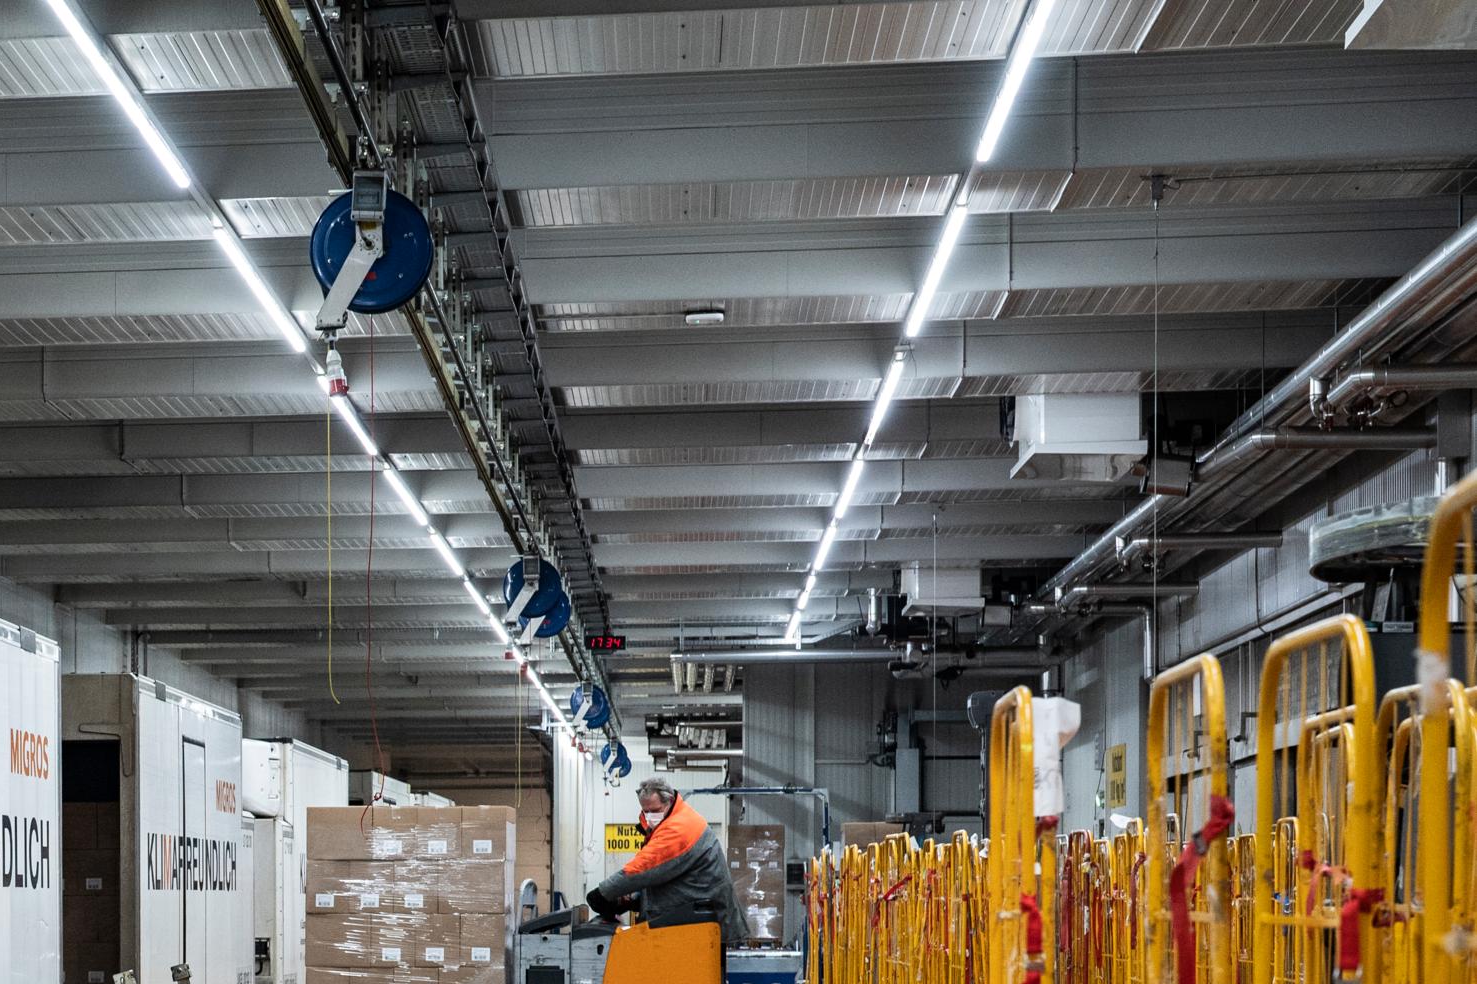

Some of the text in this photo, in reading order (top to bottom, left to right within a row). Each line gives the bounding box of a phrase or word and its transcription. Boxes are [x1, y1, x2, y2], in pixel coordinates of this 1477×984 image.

[10, 728, 49, 780] MIGROS
[216, 780, 236, 814] MIGROS
[607, 839, 630, 850] 1000
[617, 826, 641, 837] Nutz
[147, 832, 237, 892] KLIMAFREUNDLICH
